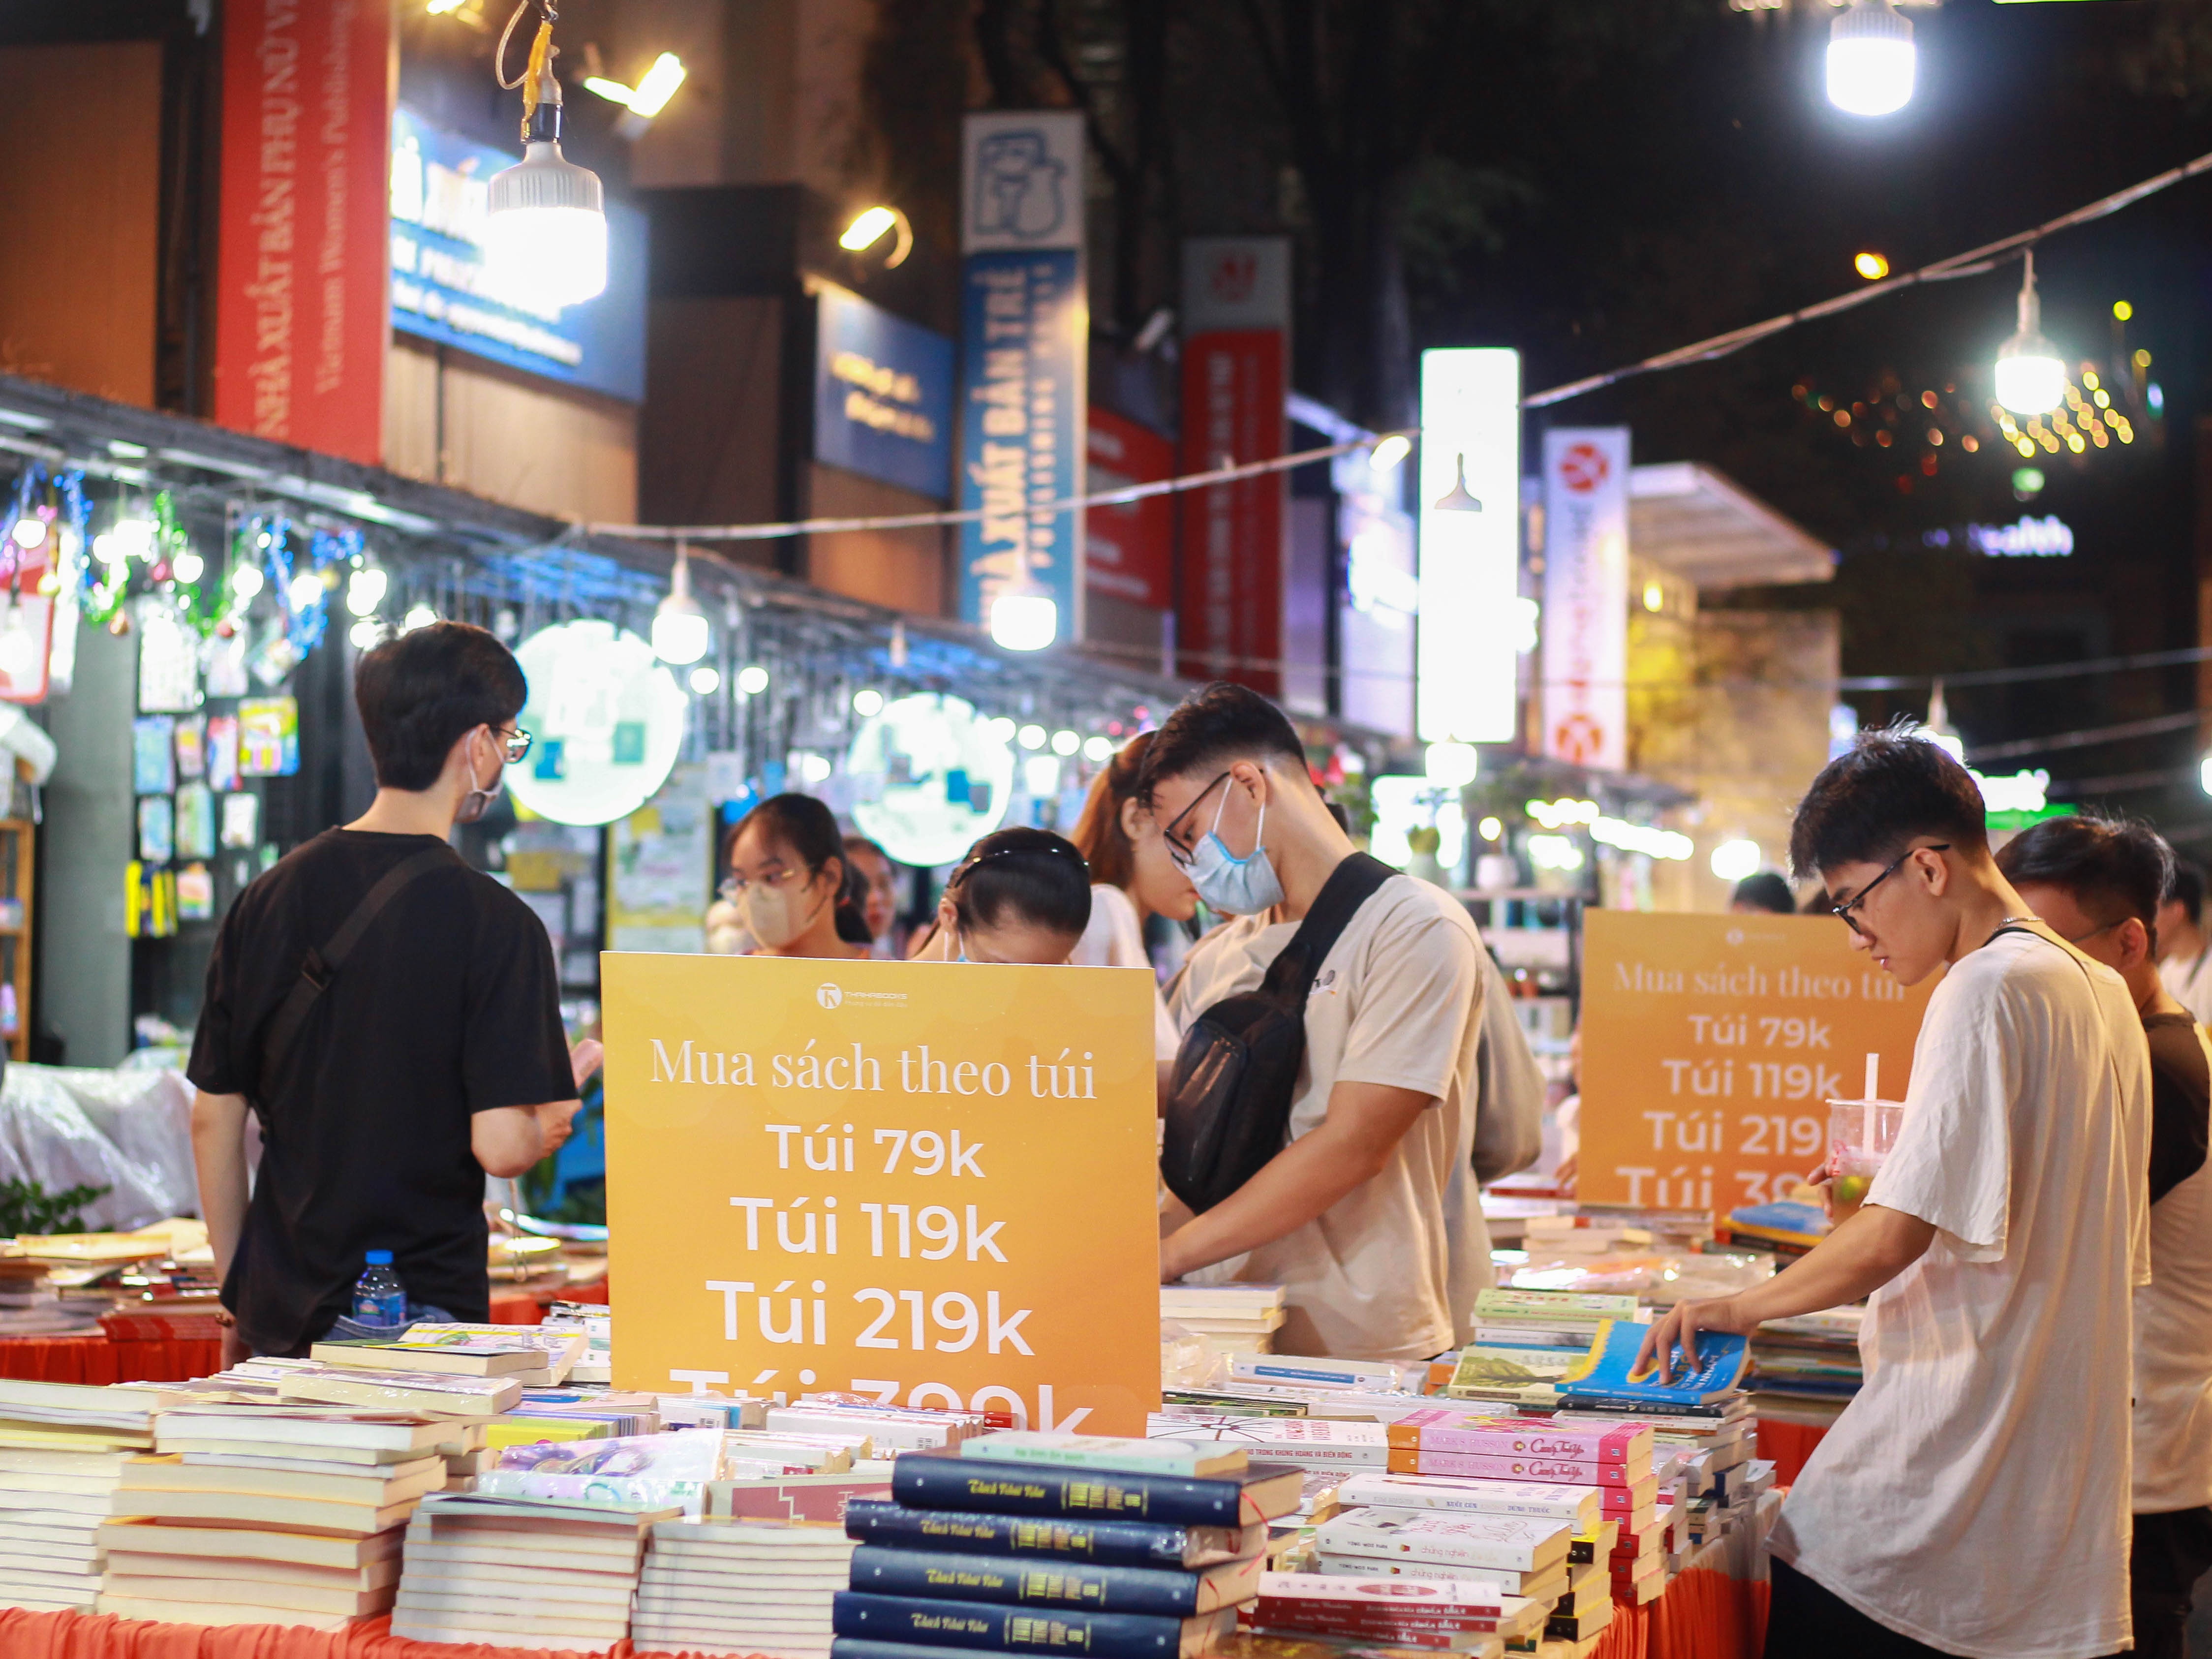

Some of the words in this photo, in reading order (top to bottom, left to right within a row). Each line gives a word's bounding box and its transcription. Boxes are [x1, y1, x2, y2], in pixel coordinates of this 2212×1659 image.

[244, 256, 292, 349] XUẤT
[970, 349, 1026, 436] BẢN
[967, 443, 1026, 544] XUẤT
[1616, 961, 1683, 993] Mua
[1694, 961, 1767, 997] sách
[1779, 965, 1850, 1000] theo
[1688, 1014, 1747, 1045] Túi
[1760, 1017, 1831, 1049] 79k
[650, 1039, 756, 1086] Mua
[771, 1039, 884, 1092] sách
[896, 1045, 1010, 1097] theo
[1025, 1048, 1097, 1100] túi
[1662, 1060, 1733, 1097] Túi
[1748, 1063, 1842, 1100] 119k
[765, 1123, 854, 1173] Túi
[873, 1129, 985, 1178] 79k
[1643, 1111, 1723, 1153] Túi
[1740, 1114, 1831, 1156] 219
[1615, 1166, 1714, 1207] Túi
[730, 1196, 837, 1255] Túi
[860, 1203, 1009, 1264] 119k
[706, 1279, 827, 1346] Túi
[855, 1287, 1035, 1356] 219k
